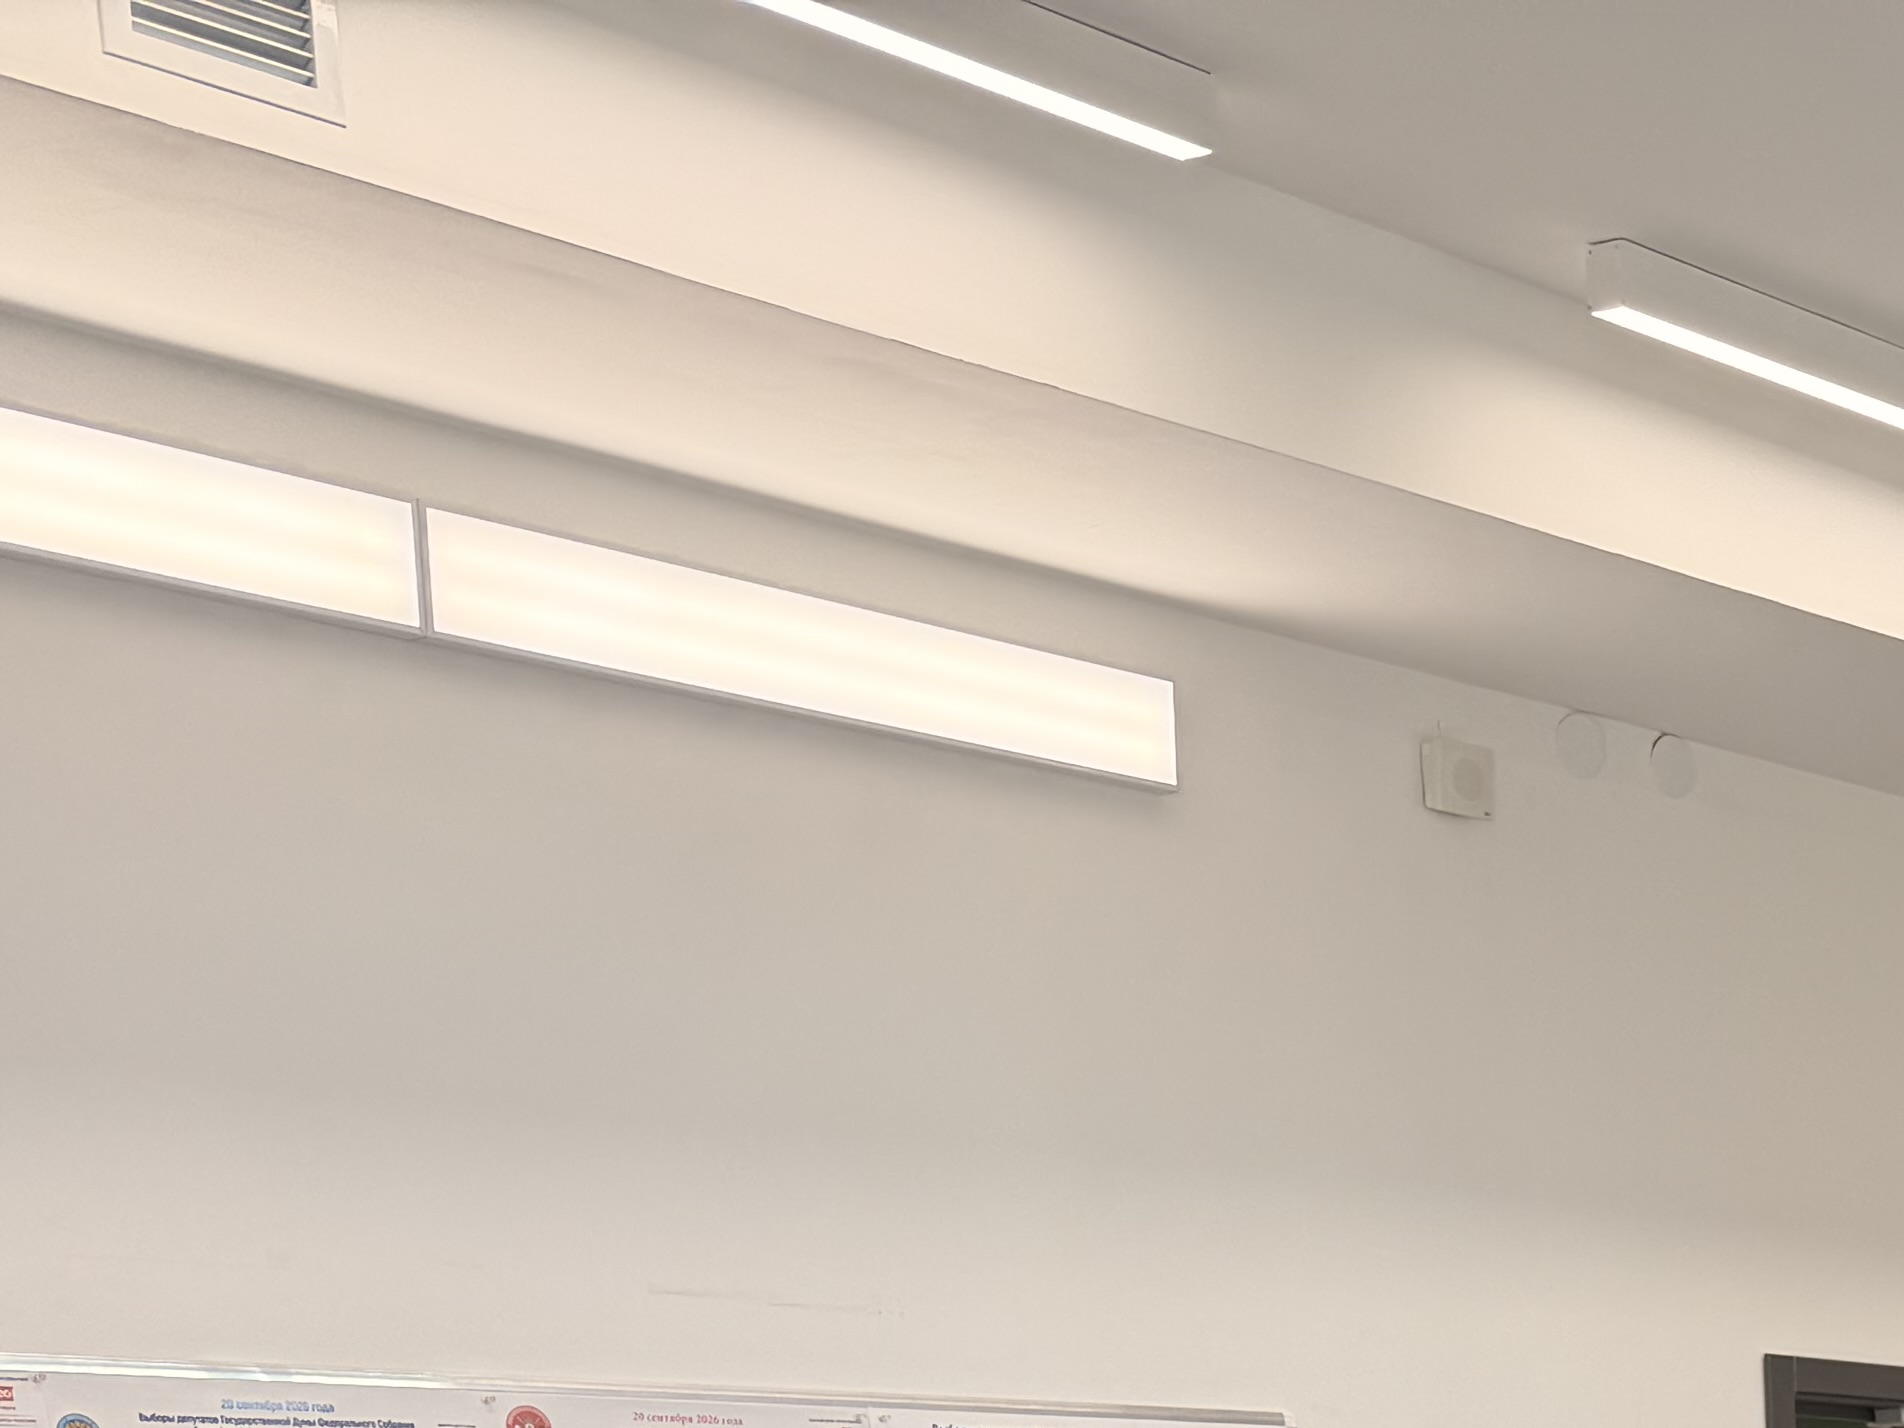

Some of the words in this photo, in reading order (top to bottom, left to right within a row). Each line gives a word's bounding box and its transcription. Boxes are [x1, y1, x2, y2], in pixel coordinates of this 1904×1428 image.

[633, 1412, 644, 1422] 20
[647, 1414, 692, 1426] сентября
[697, 1414, 719, 1425] 2026
